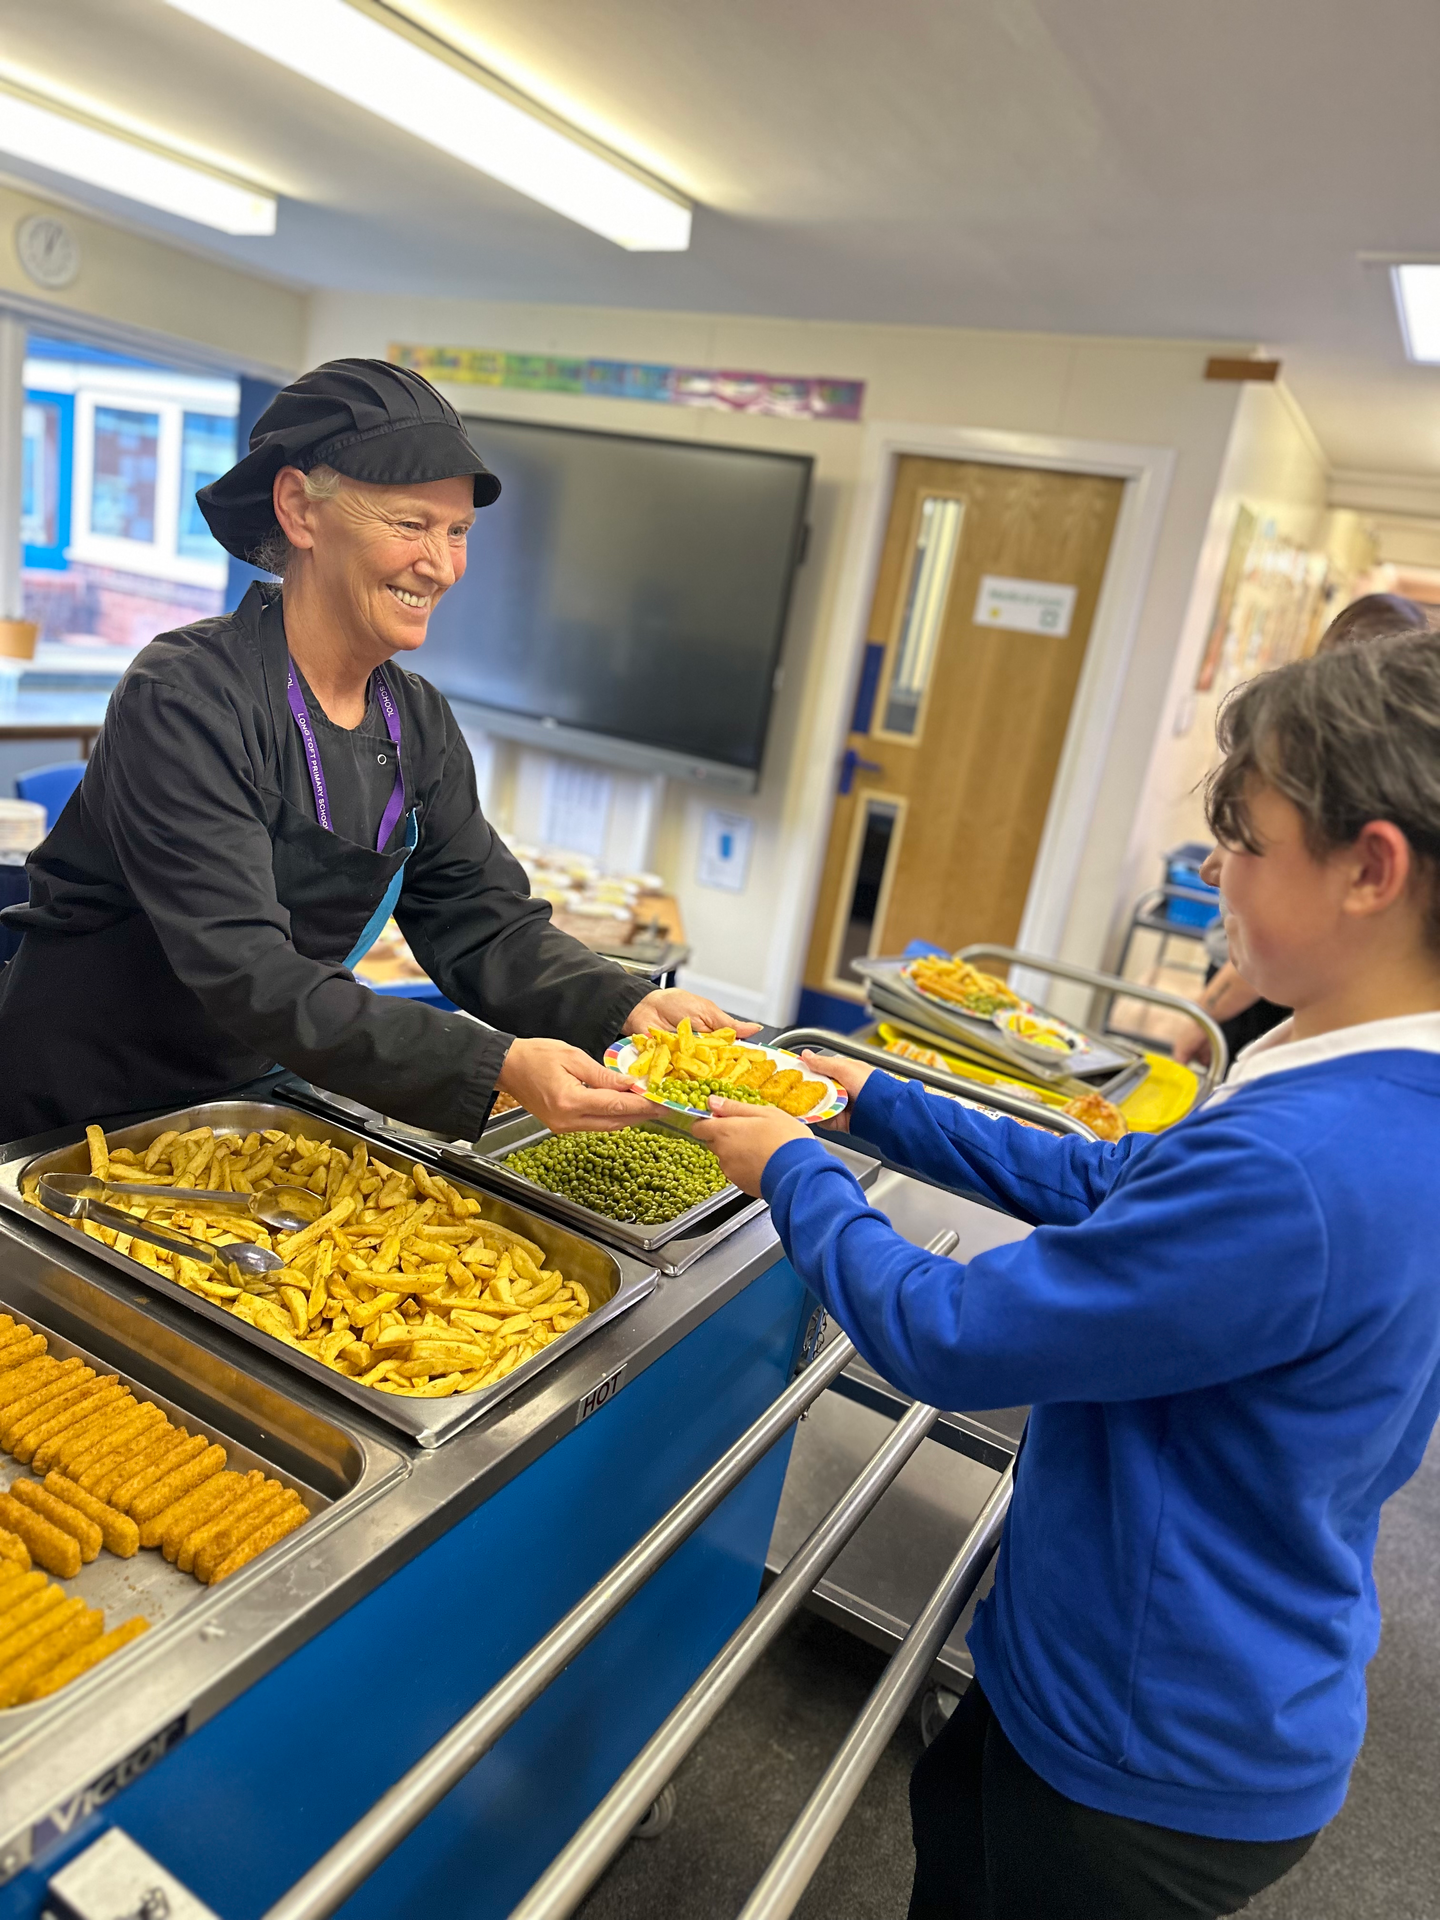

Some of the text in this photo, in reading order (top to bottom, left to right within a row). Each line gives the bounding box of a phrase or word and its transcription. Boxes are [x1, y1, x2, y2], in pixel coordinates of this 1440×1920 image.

[379, 685, 395, 718] SCHOOL
[297, 712, 311, 736] LONG
[306, 736, 317, 759] TOFT
[311, 759, 324, 797] PRIMARY
[582, 1370, 622, 1419] HOT
[48, 1719, 182, 1834] Victor
